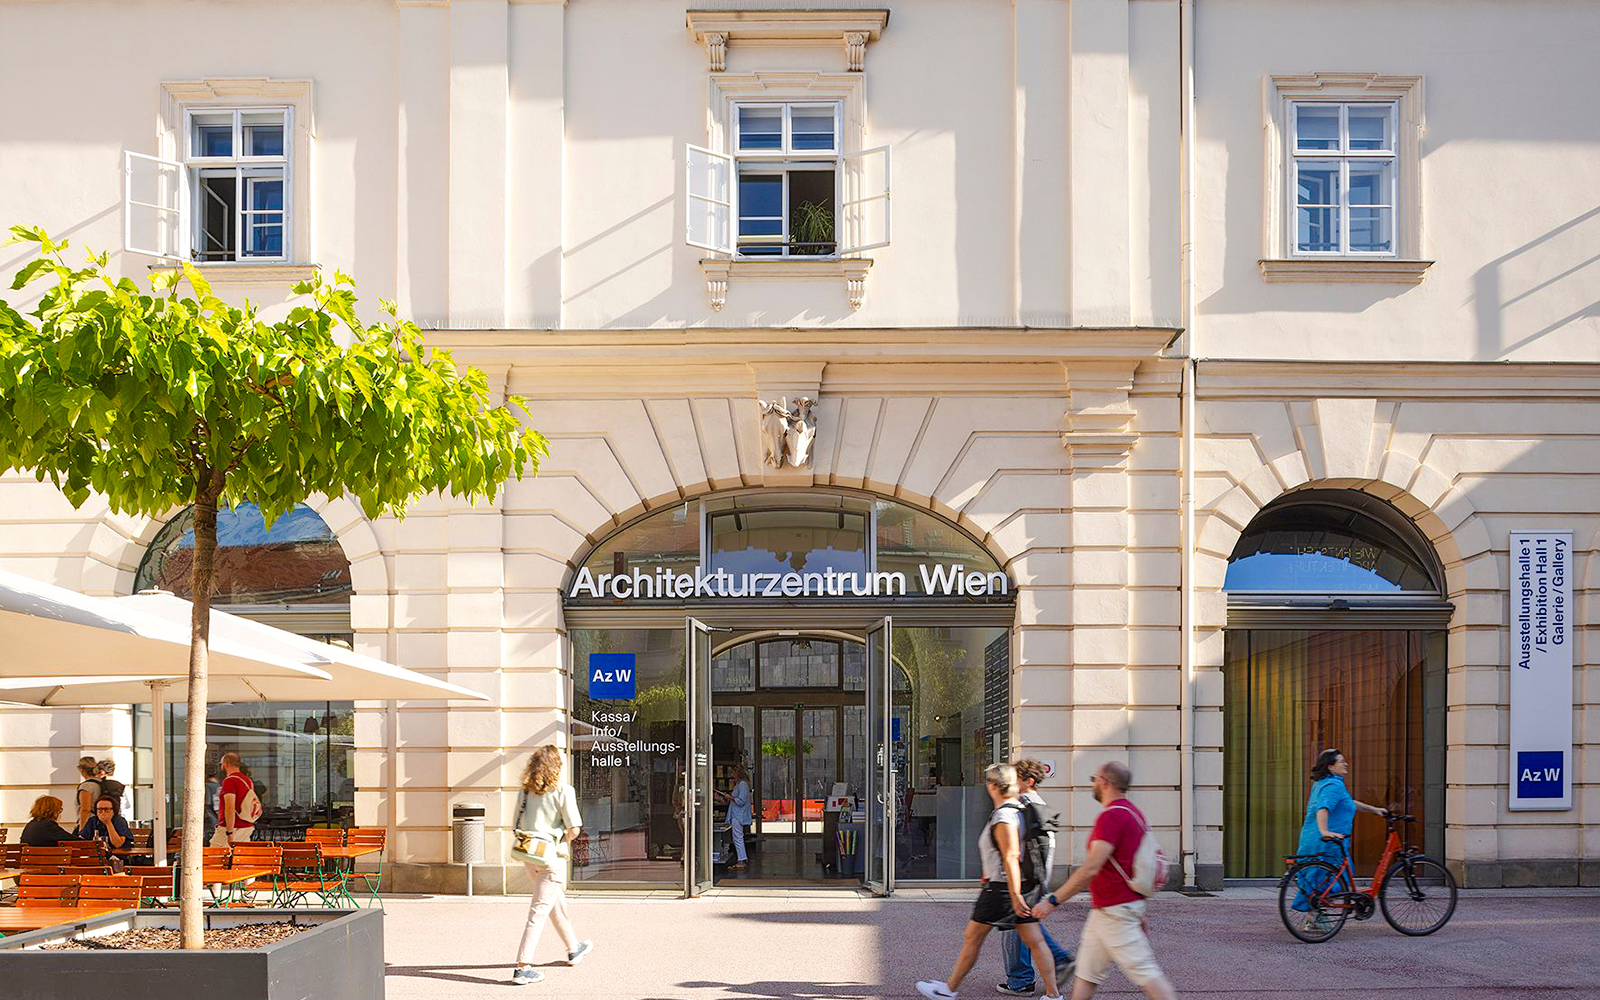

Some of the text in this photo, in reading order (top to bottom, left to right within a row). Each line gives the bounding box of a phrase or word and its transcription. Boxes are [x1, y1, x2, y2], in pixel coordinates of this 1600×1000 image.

[1536, 547, 1547, 574] Hall
[570, 563, 1008, 598] Architekturzentrum Wien
[1519, 547, 1533, 669] Ausstellungshalle
[591, 725, 623, 737] Info/
[591, 740, 681, 755] Ausstellungs-
[591, 755, 631, 767] halle 1
